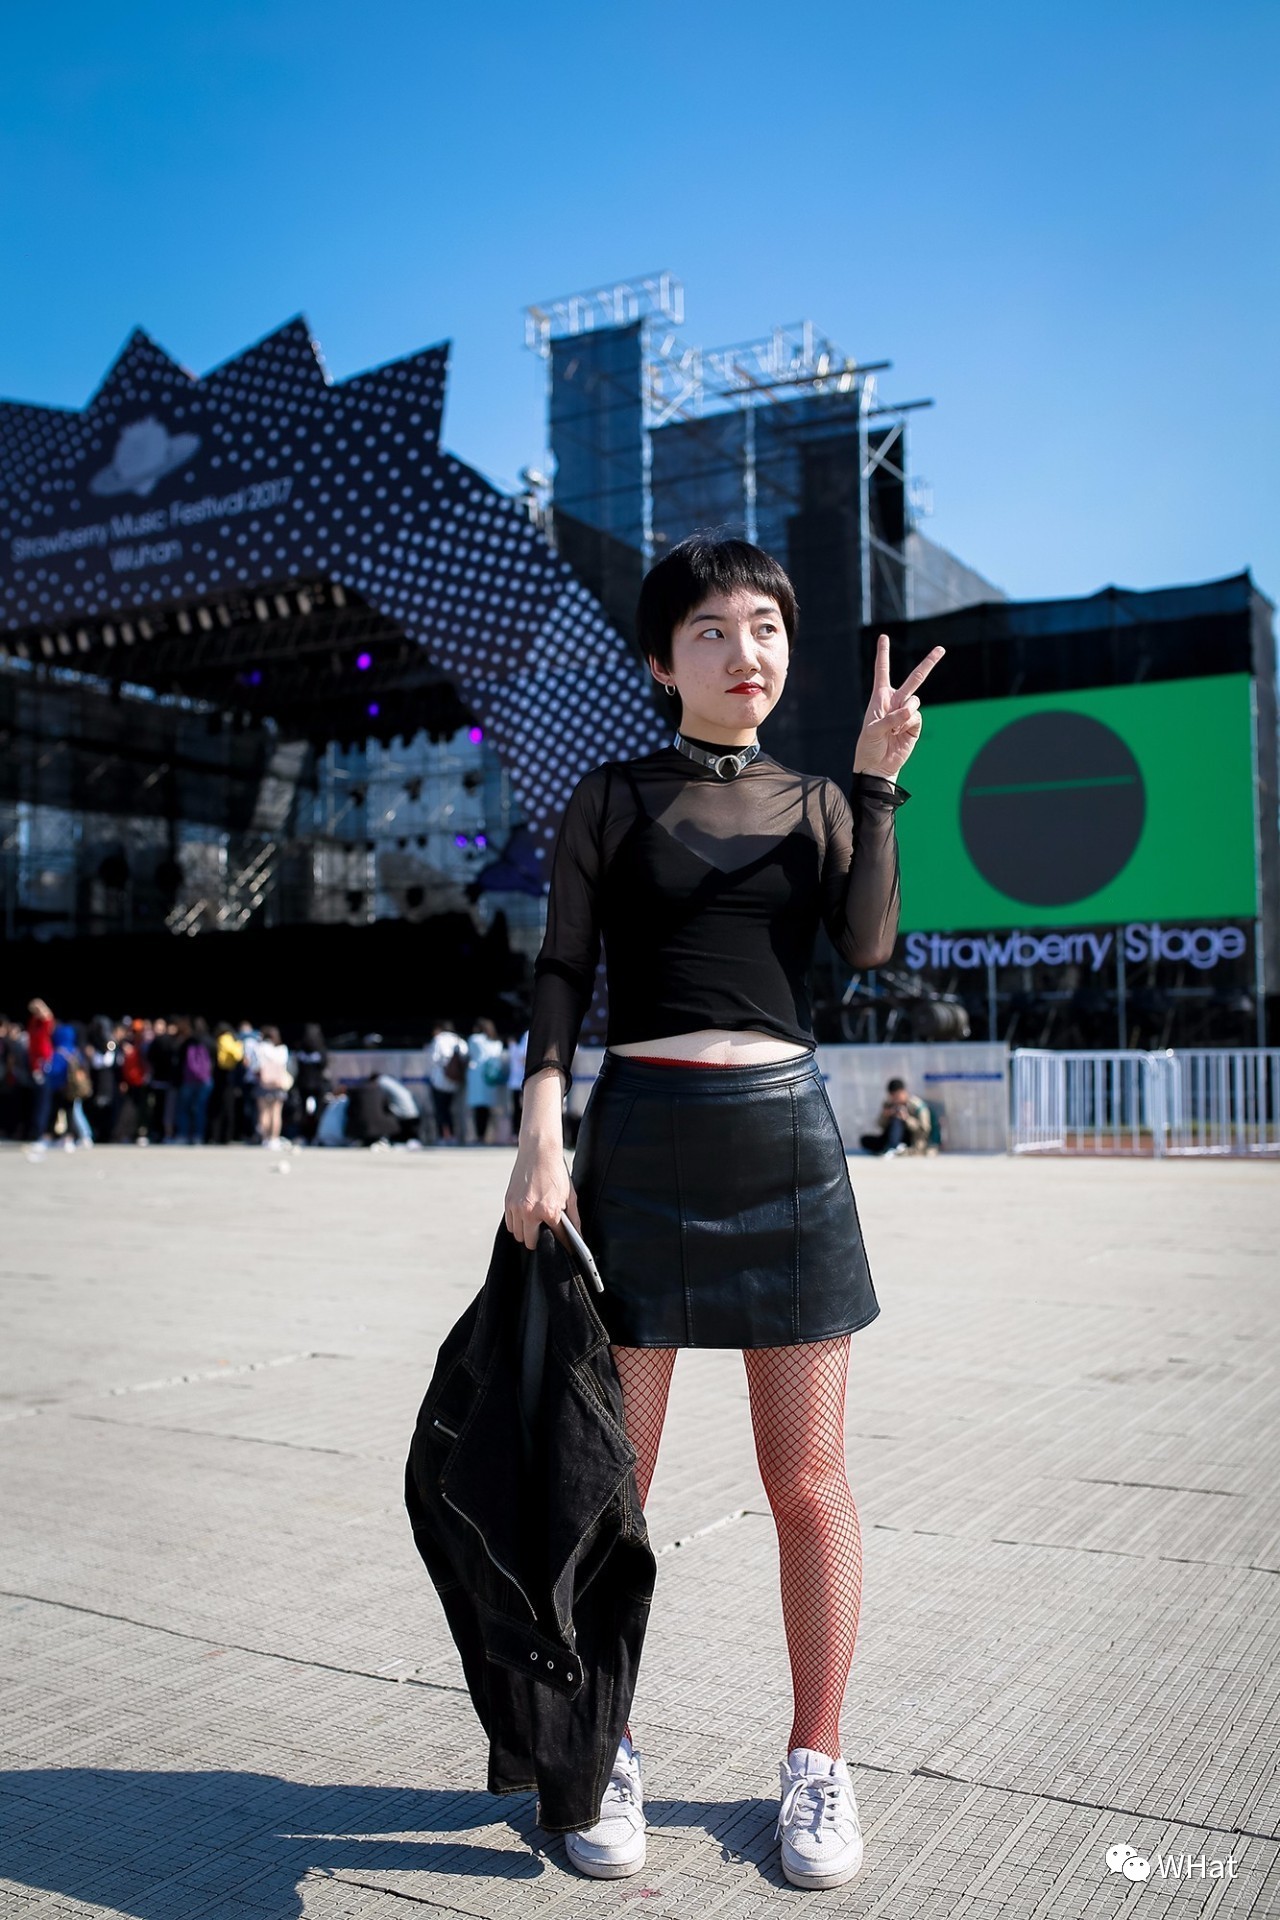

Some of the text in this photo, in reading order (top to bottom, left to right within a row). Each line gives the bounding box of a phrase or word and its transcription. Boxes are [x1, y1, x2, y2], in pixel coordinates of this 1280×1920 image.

[11, 476, 293, 562] Strawberry Music Festival 2017
[109, 539, 183, 572] Wuhan
[906, 922, 1246, 971] Strawberry Stage
